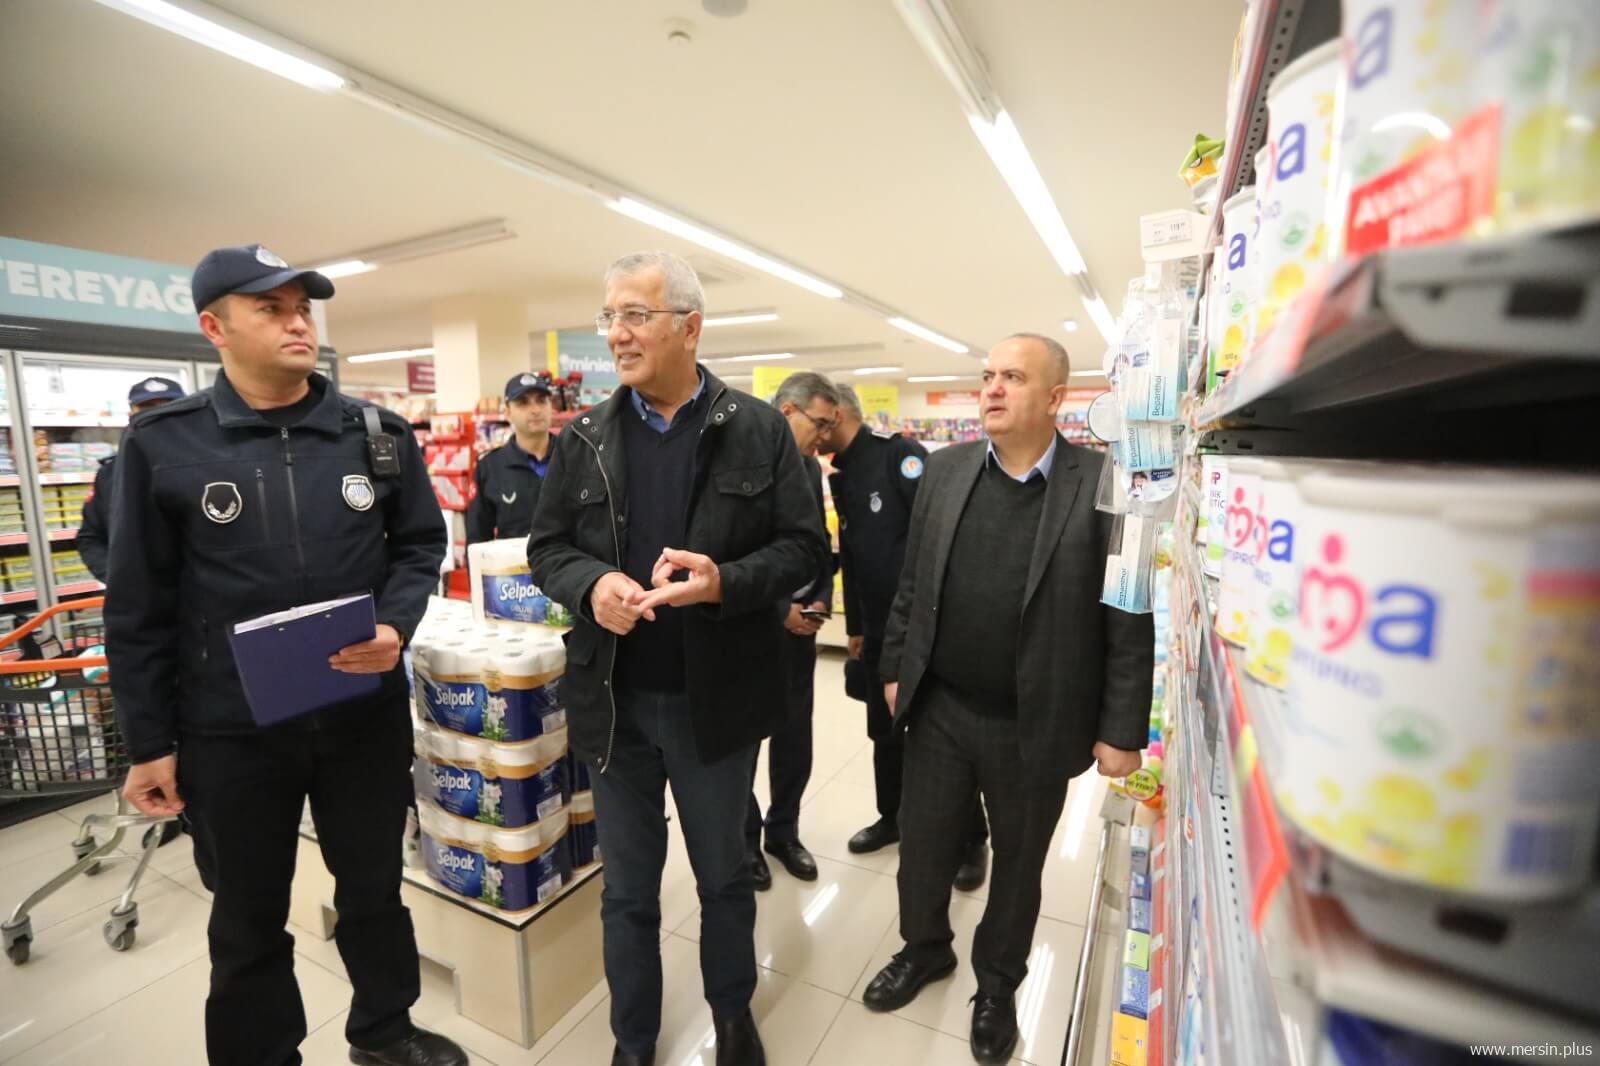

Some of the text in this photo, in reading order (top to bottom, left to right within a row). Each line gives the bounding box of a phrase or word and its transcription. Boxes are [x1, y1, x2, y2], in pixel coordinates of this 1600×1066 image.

[1349, 6, 1394, 89] a
[0, 258, 196, 315] EREYAĞ
[435, 687, 475, 709] Selpak
[431, 768, 472, 792] Selpak
[437, 850, 475, 872] Selpak
